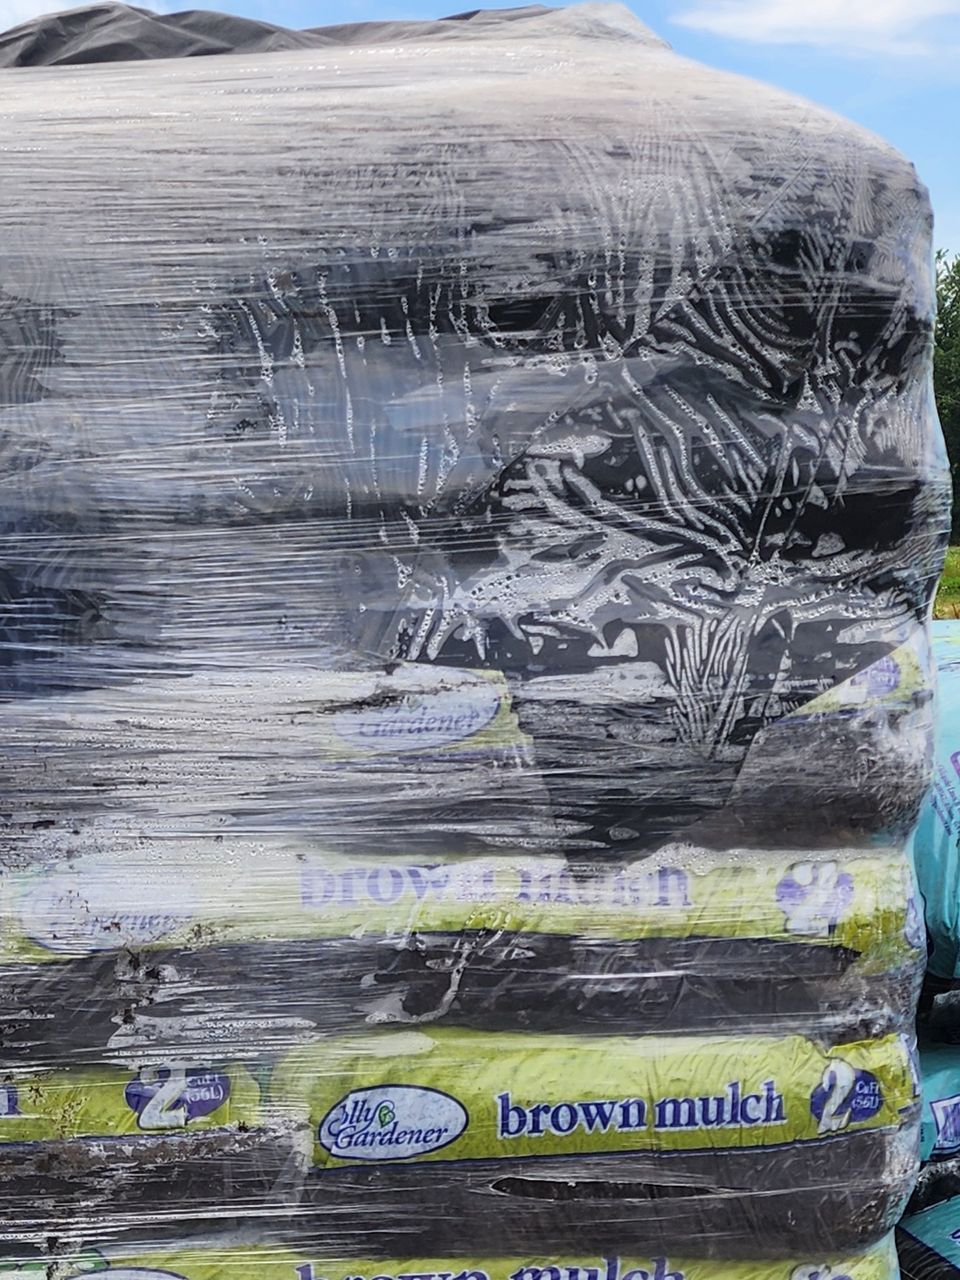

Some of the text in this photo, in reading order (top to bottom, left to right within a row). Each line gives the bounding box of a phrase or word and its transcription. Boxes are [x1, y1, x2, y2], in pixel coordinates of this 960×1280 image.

[137, 1062, 187, 1130] 2
[497, 1079, 788, 1139] brown mulch
[817, 1058, 857, 1135] 2
[334, 1120, 448, 1150] Gardener
